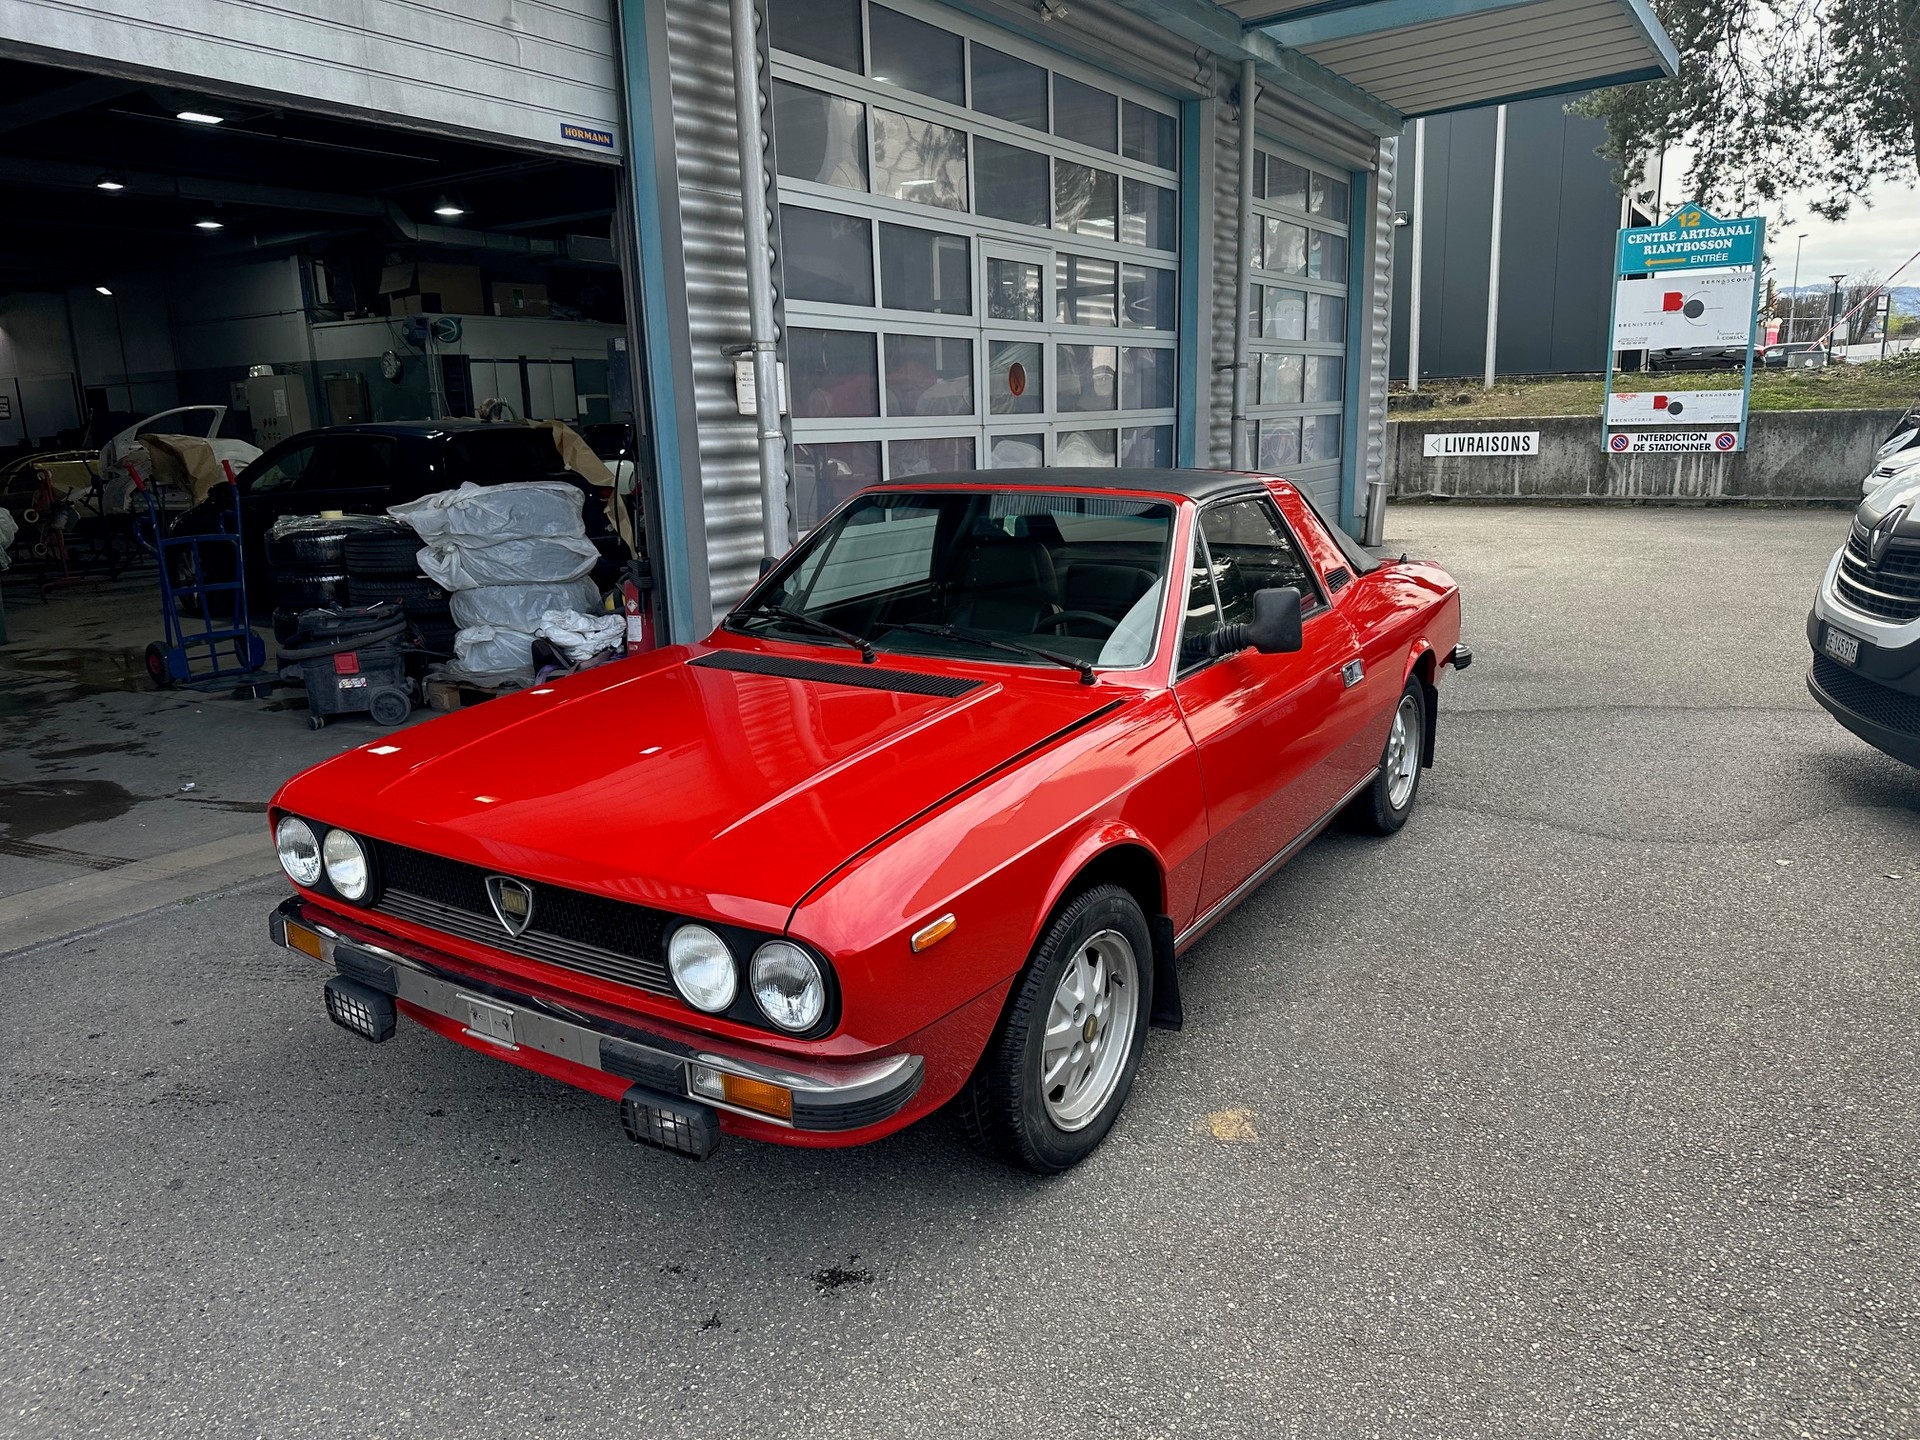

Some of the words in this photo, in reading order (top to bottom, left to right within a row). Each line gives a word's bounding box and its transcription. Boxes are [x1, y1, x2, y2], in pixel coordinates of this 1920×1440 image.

[1678, 212, 1701, 227] 12
[1627, 230, 1677, 245] CENTRE
[1680, 224, 1753, 240] ARTISANAL
[1643, 238, 1733, 255] RIANTBOSSON
[1690, 251, 1729, 263] ENTRÉE
[1444, 435, 1531, 453] LIVRAISONS
[1637, 433, 1707, 442] INTERDICTION
[1633, 444, 1646, 452] DE
[1648, 443, 1711, 452] STATIONNER
